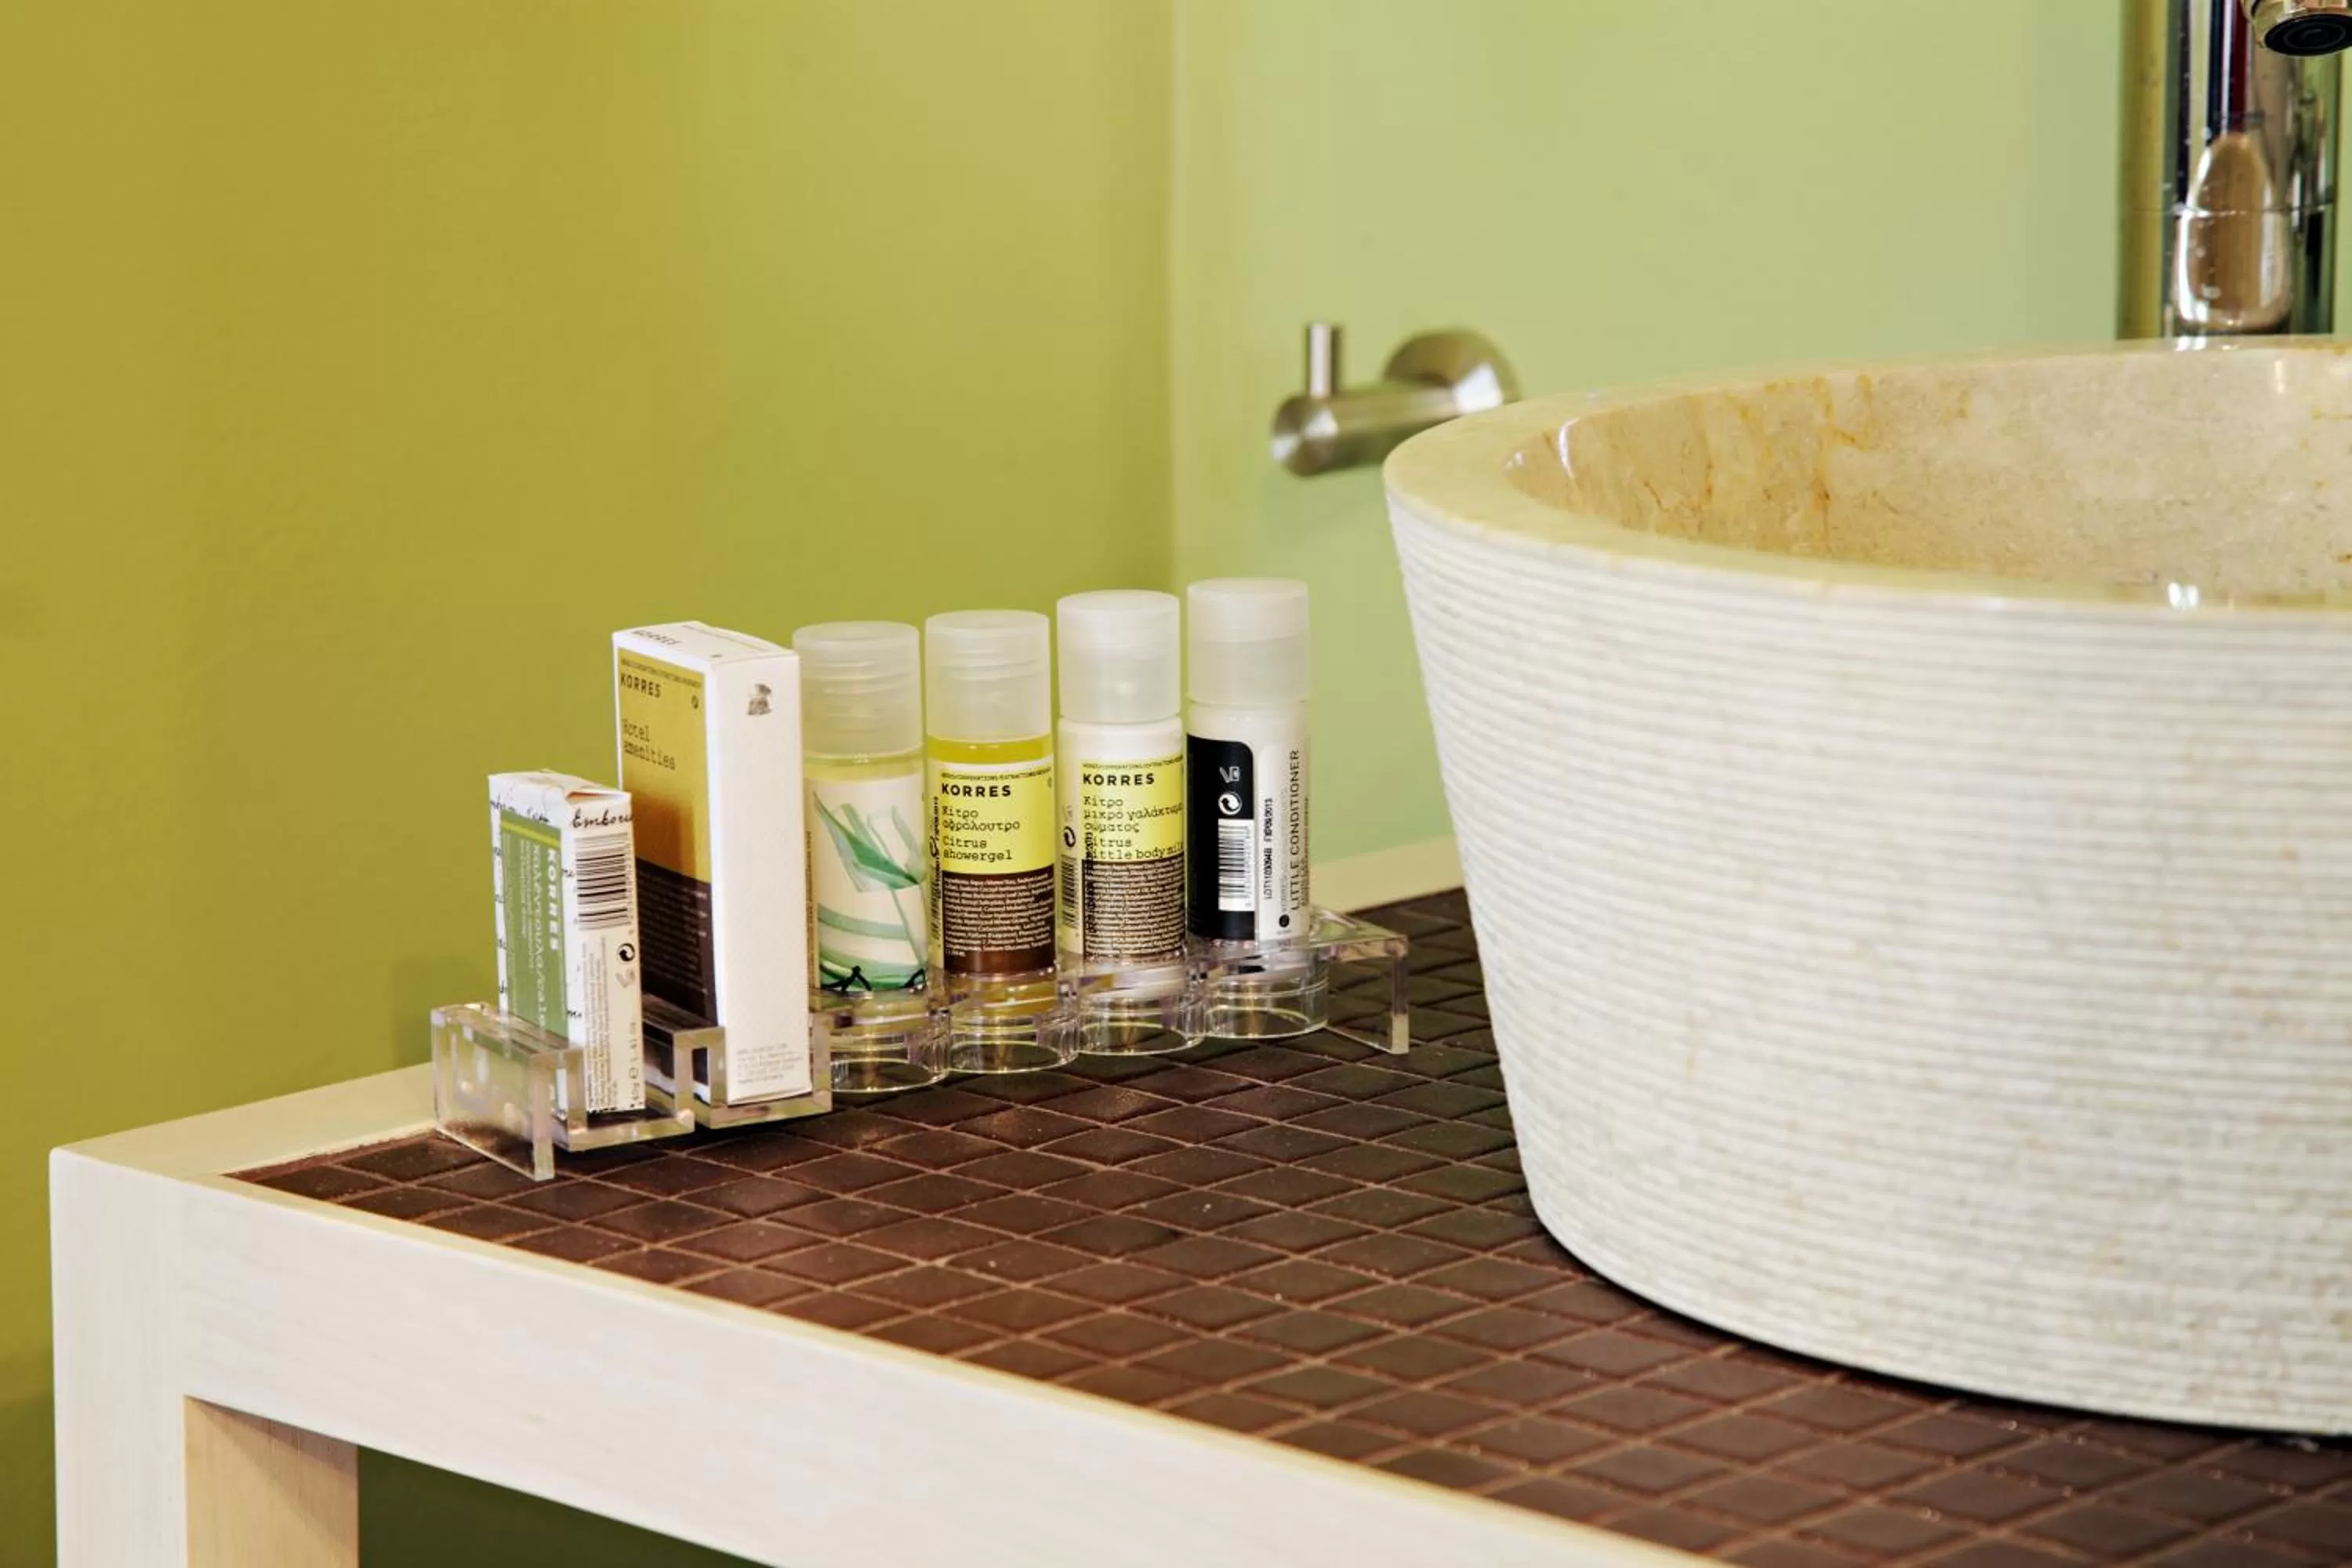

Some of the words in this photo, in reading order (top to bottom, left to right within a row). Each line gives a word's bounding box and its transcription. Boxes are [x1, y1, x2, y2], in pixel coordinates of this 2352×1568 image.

[621, 673, 662, 699] KORRES
[1083, 773, 1155, 787] KORRES
[941, 782, 1011, 798] KORRES
[1289, 750, 1301, 856] CONDITIONER
[942, 835, 988, 848] Citrus
[1086, 835, 1132, 848] itrus
[942, 848, 1013, 863] showergel
[1087, 849, 1133, 860] ittle
[1135, 847, 1166, 859] body
[548, 849, 559, 951] KORRES
